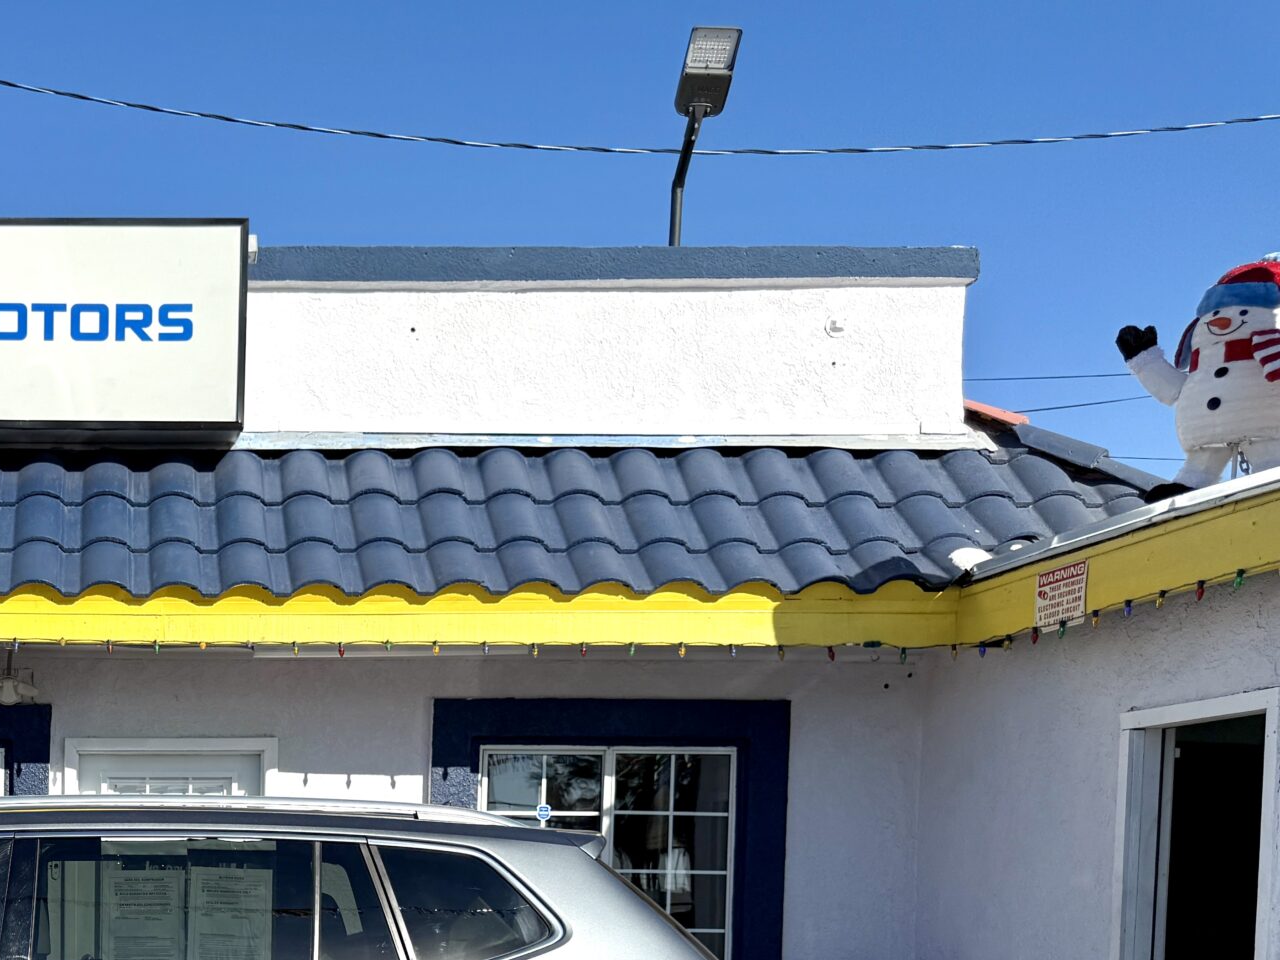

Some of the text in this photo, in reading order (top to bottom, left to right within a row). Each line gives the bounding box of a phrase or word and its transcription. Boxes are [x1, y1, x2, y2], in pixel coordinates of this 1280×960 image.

[1039, 563, 1085, 587] WARNING
[1049, 577, 1084, 593] THESE PREMISES
[1049, 594, 1057, 602] ARE
[1057, 587, 1076, 599] SECURED
[1038, 594, 1082, 614] ELECTRONIC ALARM
